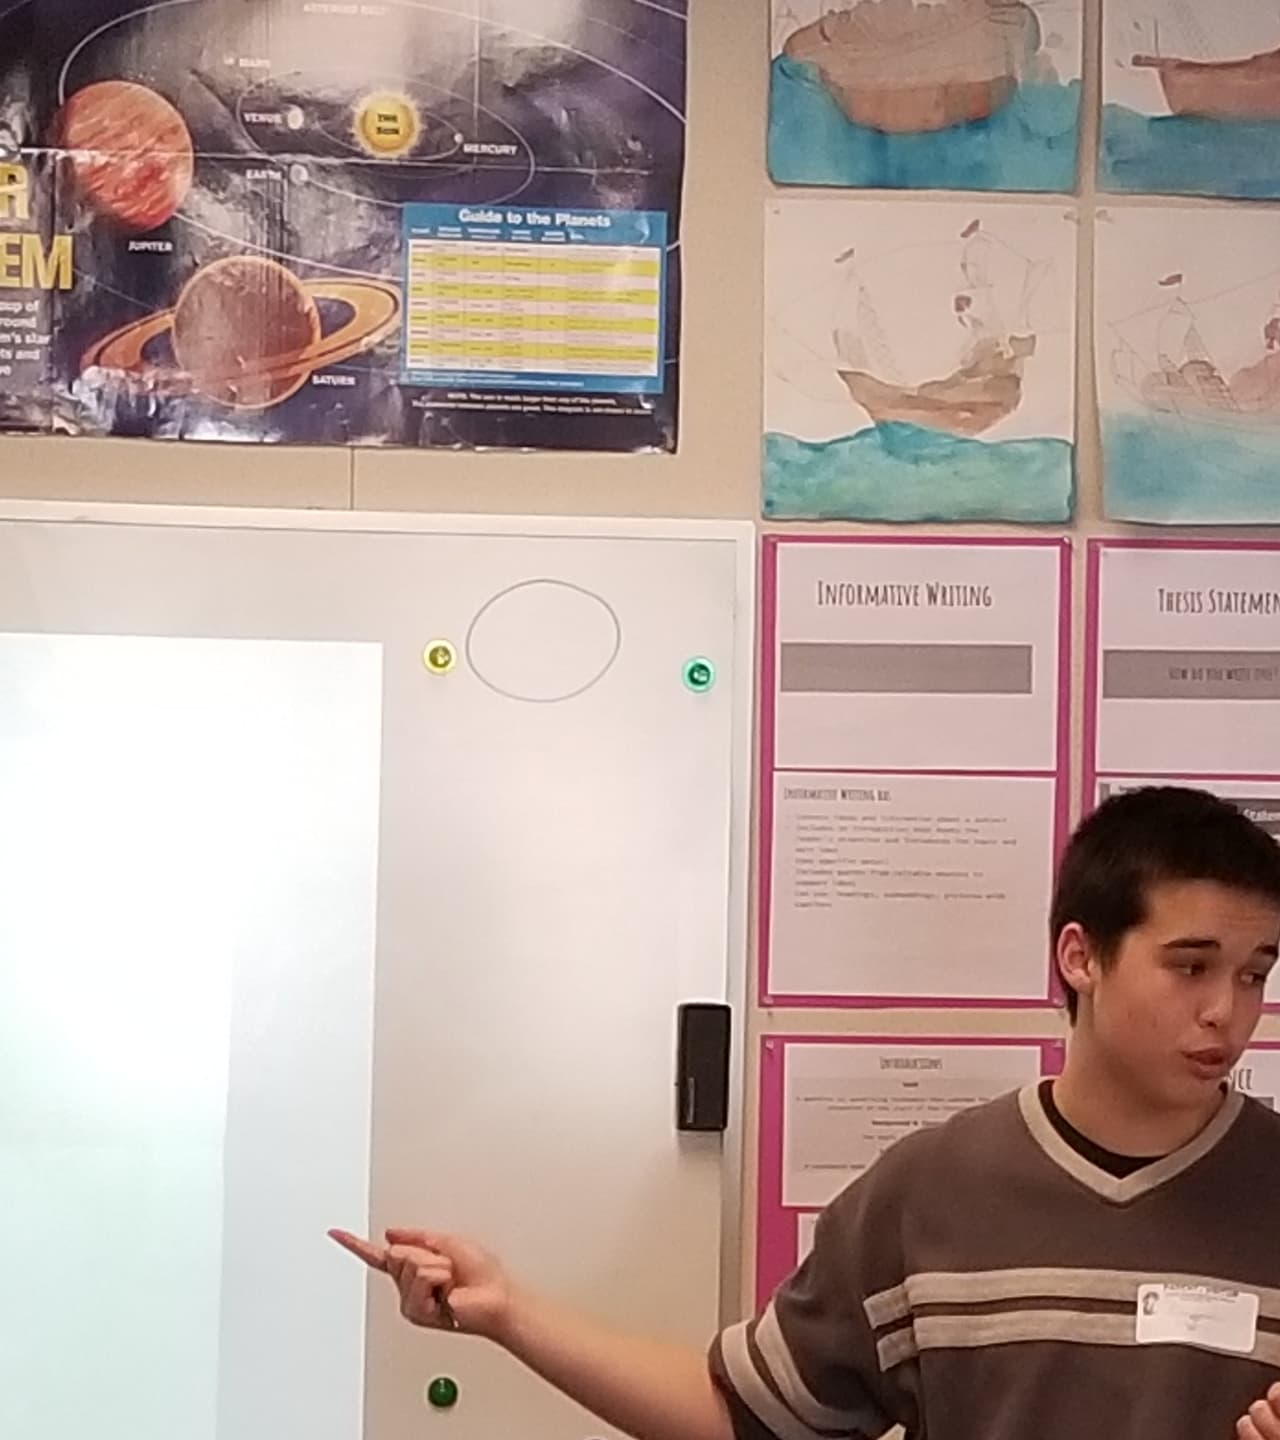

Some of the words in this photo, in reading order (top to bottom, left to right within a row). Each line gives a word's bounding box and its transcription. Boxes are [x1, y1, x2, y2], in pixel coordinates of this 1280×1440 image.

[244, 113, 283, 125] VENUS
[463, 143, 517, 156] MERCURY
[458, 208, 503, 224] Guide
[507, 210, 522, 225] to
[526, 212, 551, 226] the
[555, 213, 612, 227] Planets
[128, 240, 173, 252] JUPITER
[25, 299, 40, 312] of
[16, 349, 40, 360] and
[312, 375, 356, 387] SATURN
